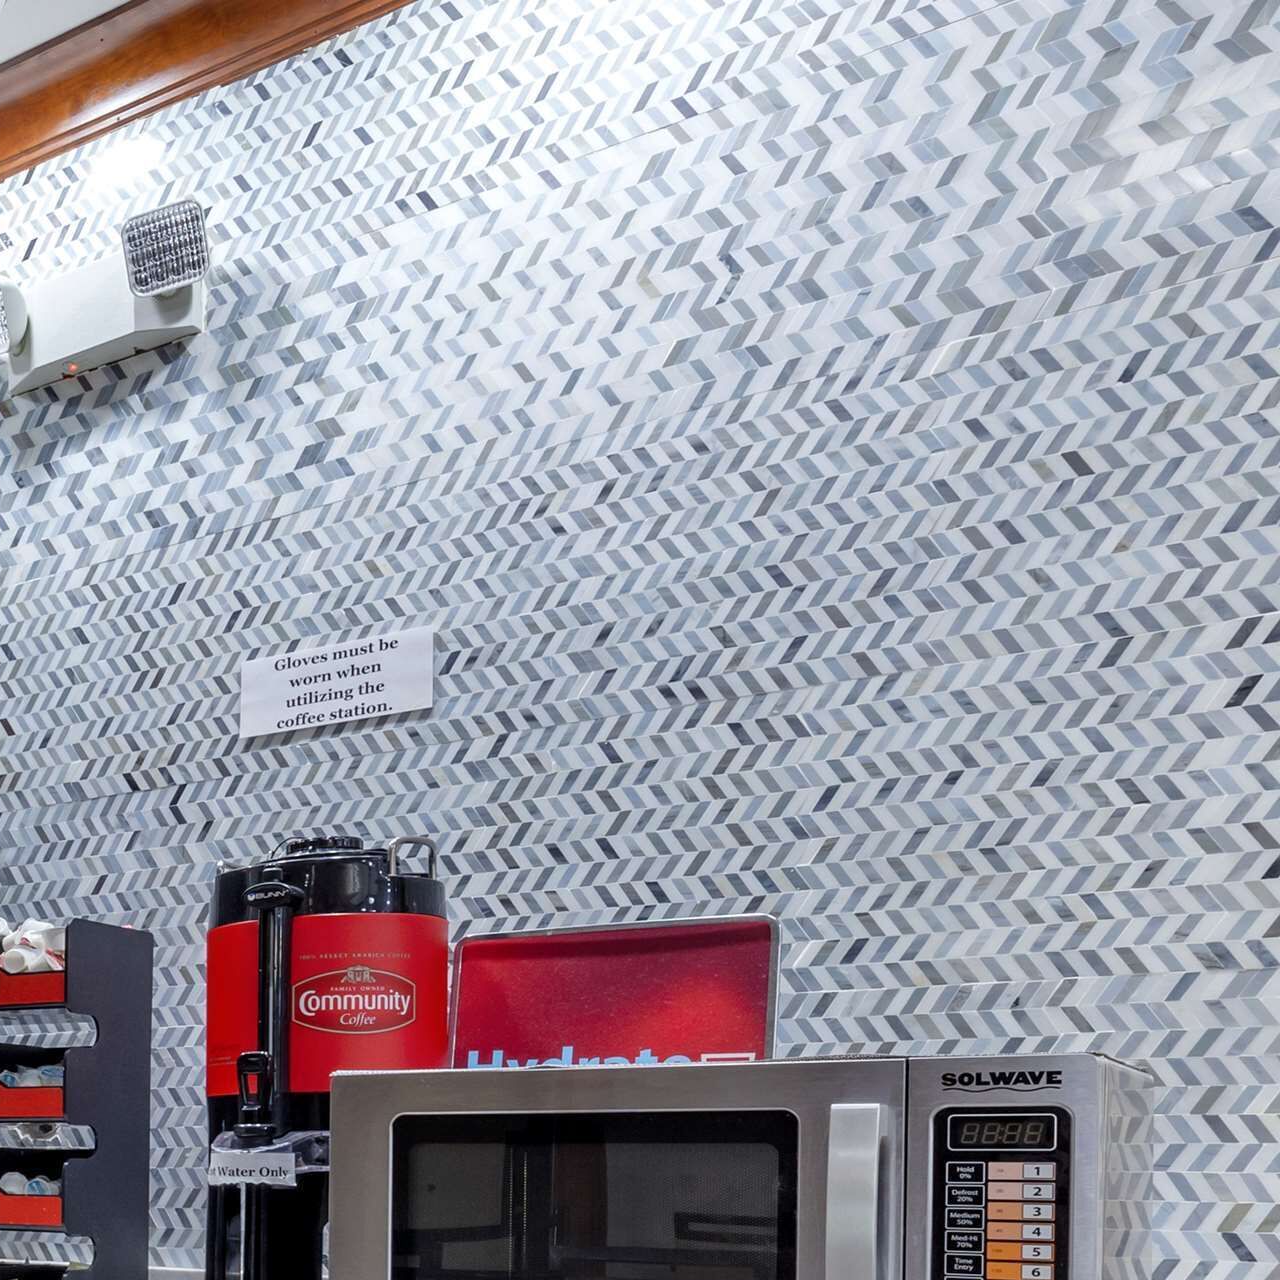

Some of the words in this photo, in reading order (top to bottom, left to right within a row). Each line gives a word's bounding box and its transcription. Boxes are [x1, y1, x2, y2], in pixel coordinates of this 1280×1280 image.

[274, 653, 328, 671] Gloves
[333, 642, 374, 660] must
[379, 639, 399, 652] be
[289, 672, 332, 688] worn
[336, 663, 381, 679] when
[286, 687, 354, 708] utilizing
[358, 681, 385, 695] the
[277, 712, 325, 729] coffee
[329, 702, 393, 720] station.
[299, 989, 410, 1016] Community
[340, 1012, 376, 1026] Coffee
[941, 1071, 1063, 1087] SOLWAVE
[217, 1167, 255, 1177] Water
[259, 1166, 289, 1179] Only
[1034, 1167, 1040, 1176] 1
[1033, 1187, 1042, 1196] 2
[1033, 1207, 1041, 1216] 3
[1032, 1227, 1041, 1236] 4
[1032, 1248, 1040, 1256] 5
[1032, 1268, 1040, 1277] 6
